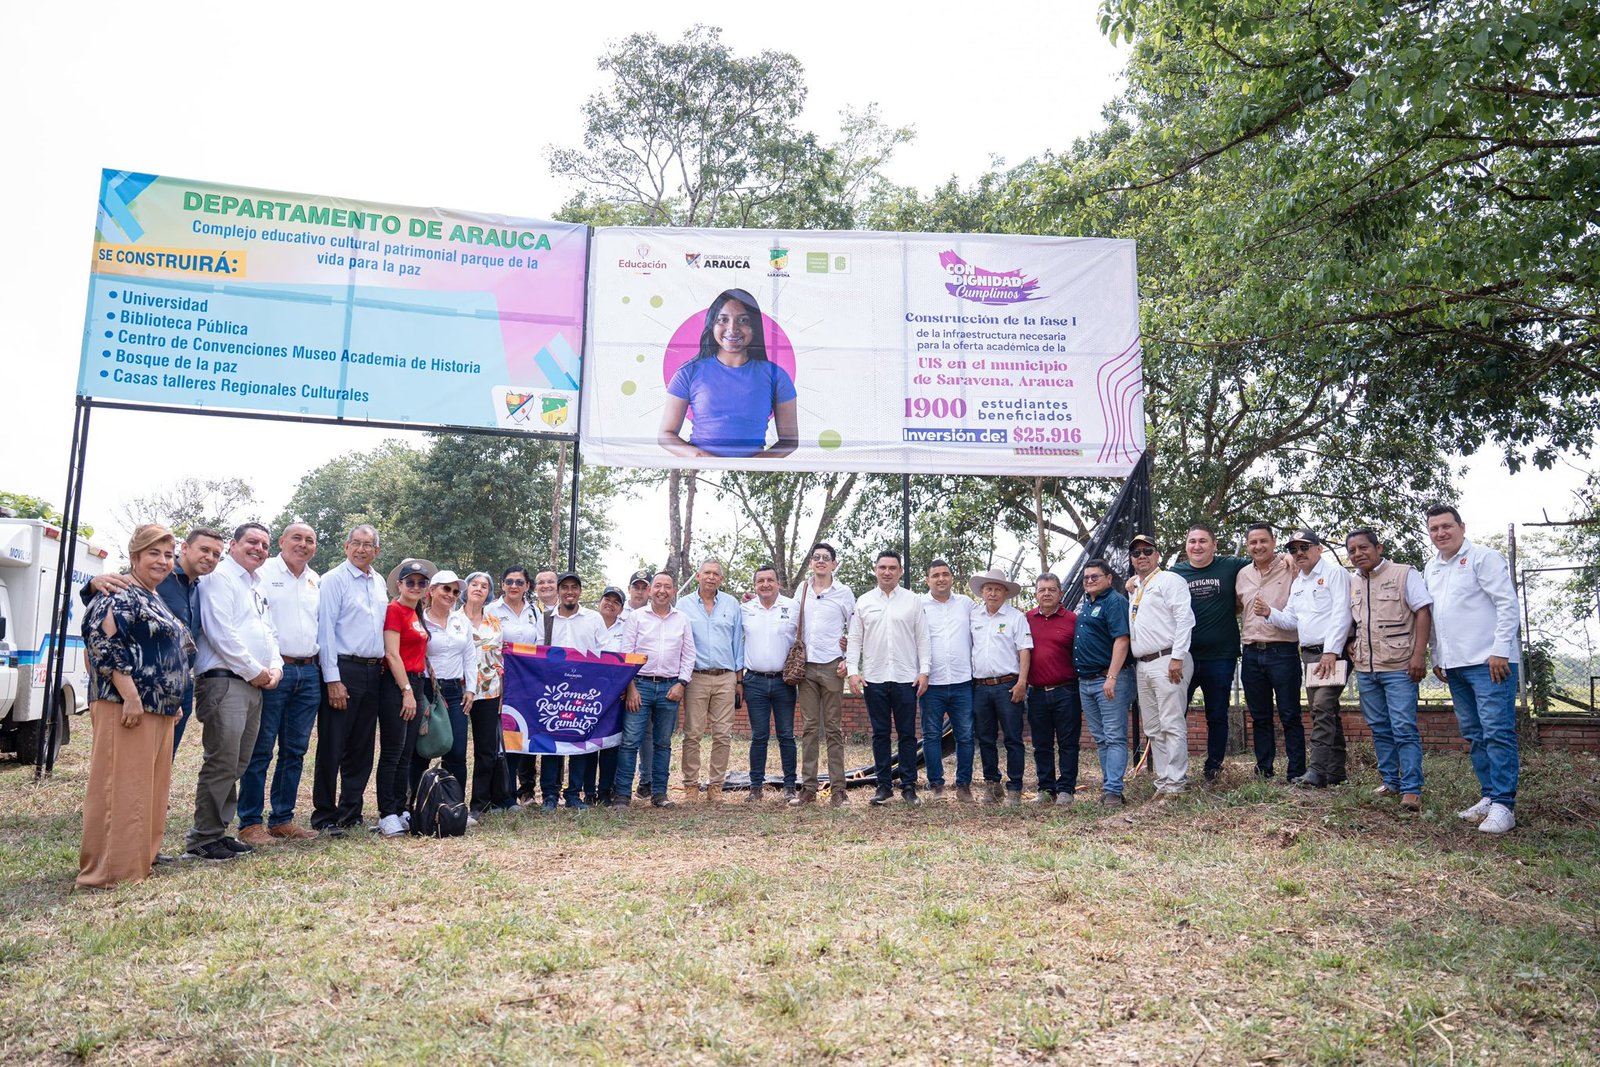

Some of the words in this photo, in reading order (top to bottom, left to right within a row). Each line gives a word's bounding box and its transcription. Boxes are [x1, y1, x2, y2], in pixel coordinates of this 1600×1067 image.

[183, 191, 401, 234] DEPARTAMENTO
[408, 218, 443, 240] DE
[449, 225, 551, 250] ARAUCA
[192, 220, 257, 241] Complejo
[261, 226, 326, 246] educativo
[330, 236, 380, 252] cultural
[384, 245, 457, 263] patrimonial
[461, 253, 504, 268] parque
[508, 255, 523, 268] de
[527, 256, 538, 269] la
[99, 248, 112, 261] SE
[116, 250, 238, 274] CONSTRUIRÁ:
[317, 252, 344, 266] vida
[349, 257, 378, 270] para
[383, 259, 394, 273] la
[399, 263, 421, 276] paz
[618, 259, 667, 269] Educación
[704, 260, 750, 269] ARAUCA
[945, 263, 977, 275] CON
[122, 290, 208, 313] Universidad
[955, 285, 1020, 301] Cumplimos
[120, 310, 192, 331] Biblioteca
[197, 318, 248, 336] Pública
[905, 311, 999, 325] Construcción
[1003, 315, 1020, 326] de
[1024, 316, 1036, 326] la
[1040, 316, 1068, 326] fase
[916, 329, 930, 338] de
[932, 329, 940, 338] la
[943, 329, 1017, 340] infraestructura
[1019, 332, 1066, 341] necesaria
[118, 329, 166, 347] Centro
[171, 336, 188, 349] de
[193, 337, 288, 358] Convenciones
[292, 345, 336, 361] Museo
[341, 349, 406, 368] Academia
[411, 356, 426, 370] de
[431, 358, 481, 374] Historia
[917, 341, 939, 351] para
[942, 340, 951, 350] la
[953, 340, 984, 351] oferta
[986, 341, 1039, 352] académica
[1042, 342, 1055, 352] de
[1057, 343, 1066, 352] la
[115, 349, 170, 368] Bosque
[174, 355, 192, 369] de
[196, 357, 209, 371] la
[213, 361, 238, 374] paz
[918, 357, 942, 369] UIS
[947, 360, 967, 370] en
[972, 359, 986, 370] el
[990, 360, 1068, 374] municipio
[113, 369, 158, 386] Casas
[163, 373, 216, 391] talleres
[221, 378, 297, 397] Regionales
[301, 384, 369, 402] Culturales
[913, 374, 931, 385] de
[1018, 376, 1074, 388] Arauca
[904, 397, 967, 419] 1900
[981, 398, 1068, 410] estudiantes
[978, 410, 1072, 421] beneficiados
[903, 428, 976, 442] Inversión
[979, 429, 1006, 443] de:
[1013, 426, 1082, 444] $25.916
[1187, 579, 1220, 588] HEVIGNON
[553, 682, 600, 701] Somos
[536, 698, 603, 716] Revolución
[546, 715, 598, 735] Cambio
